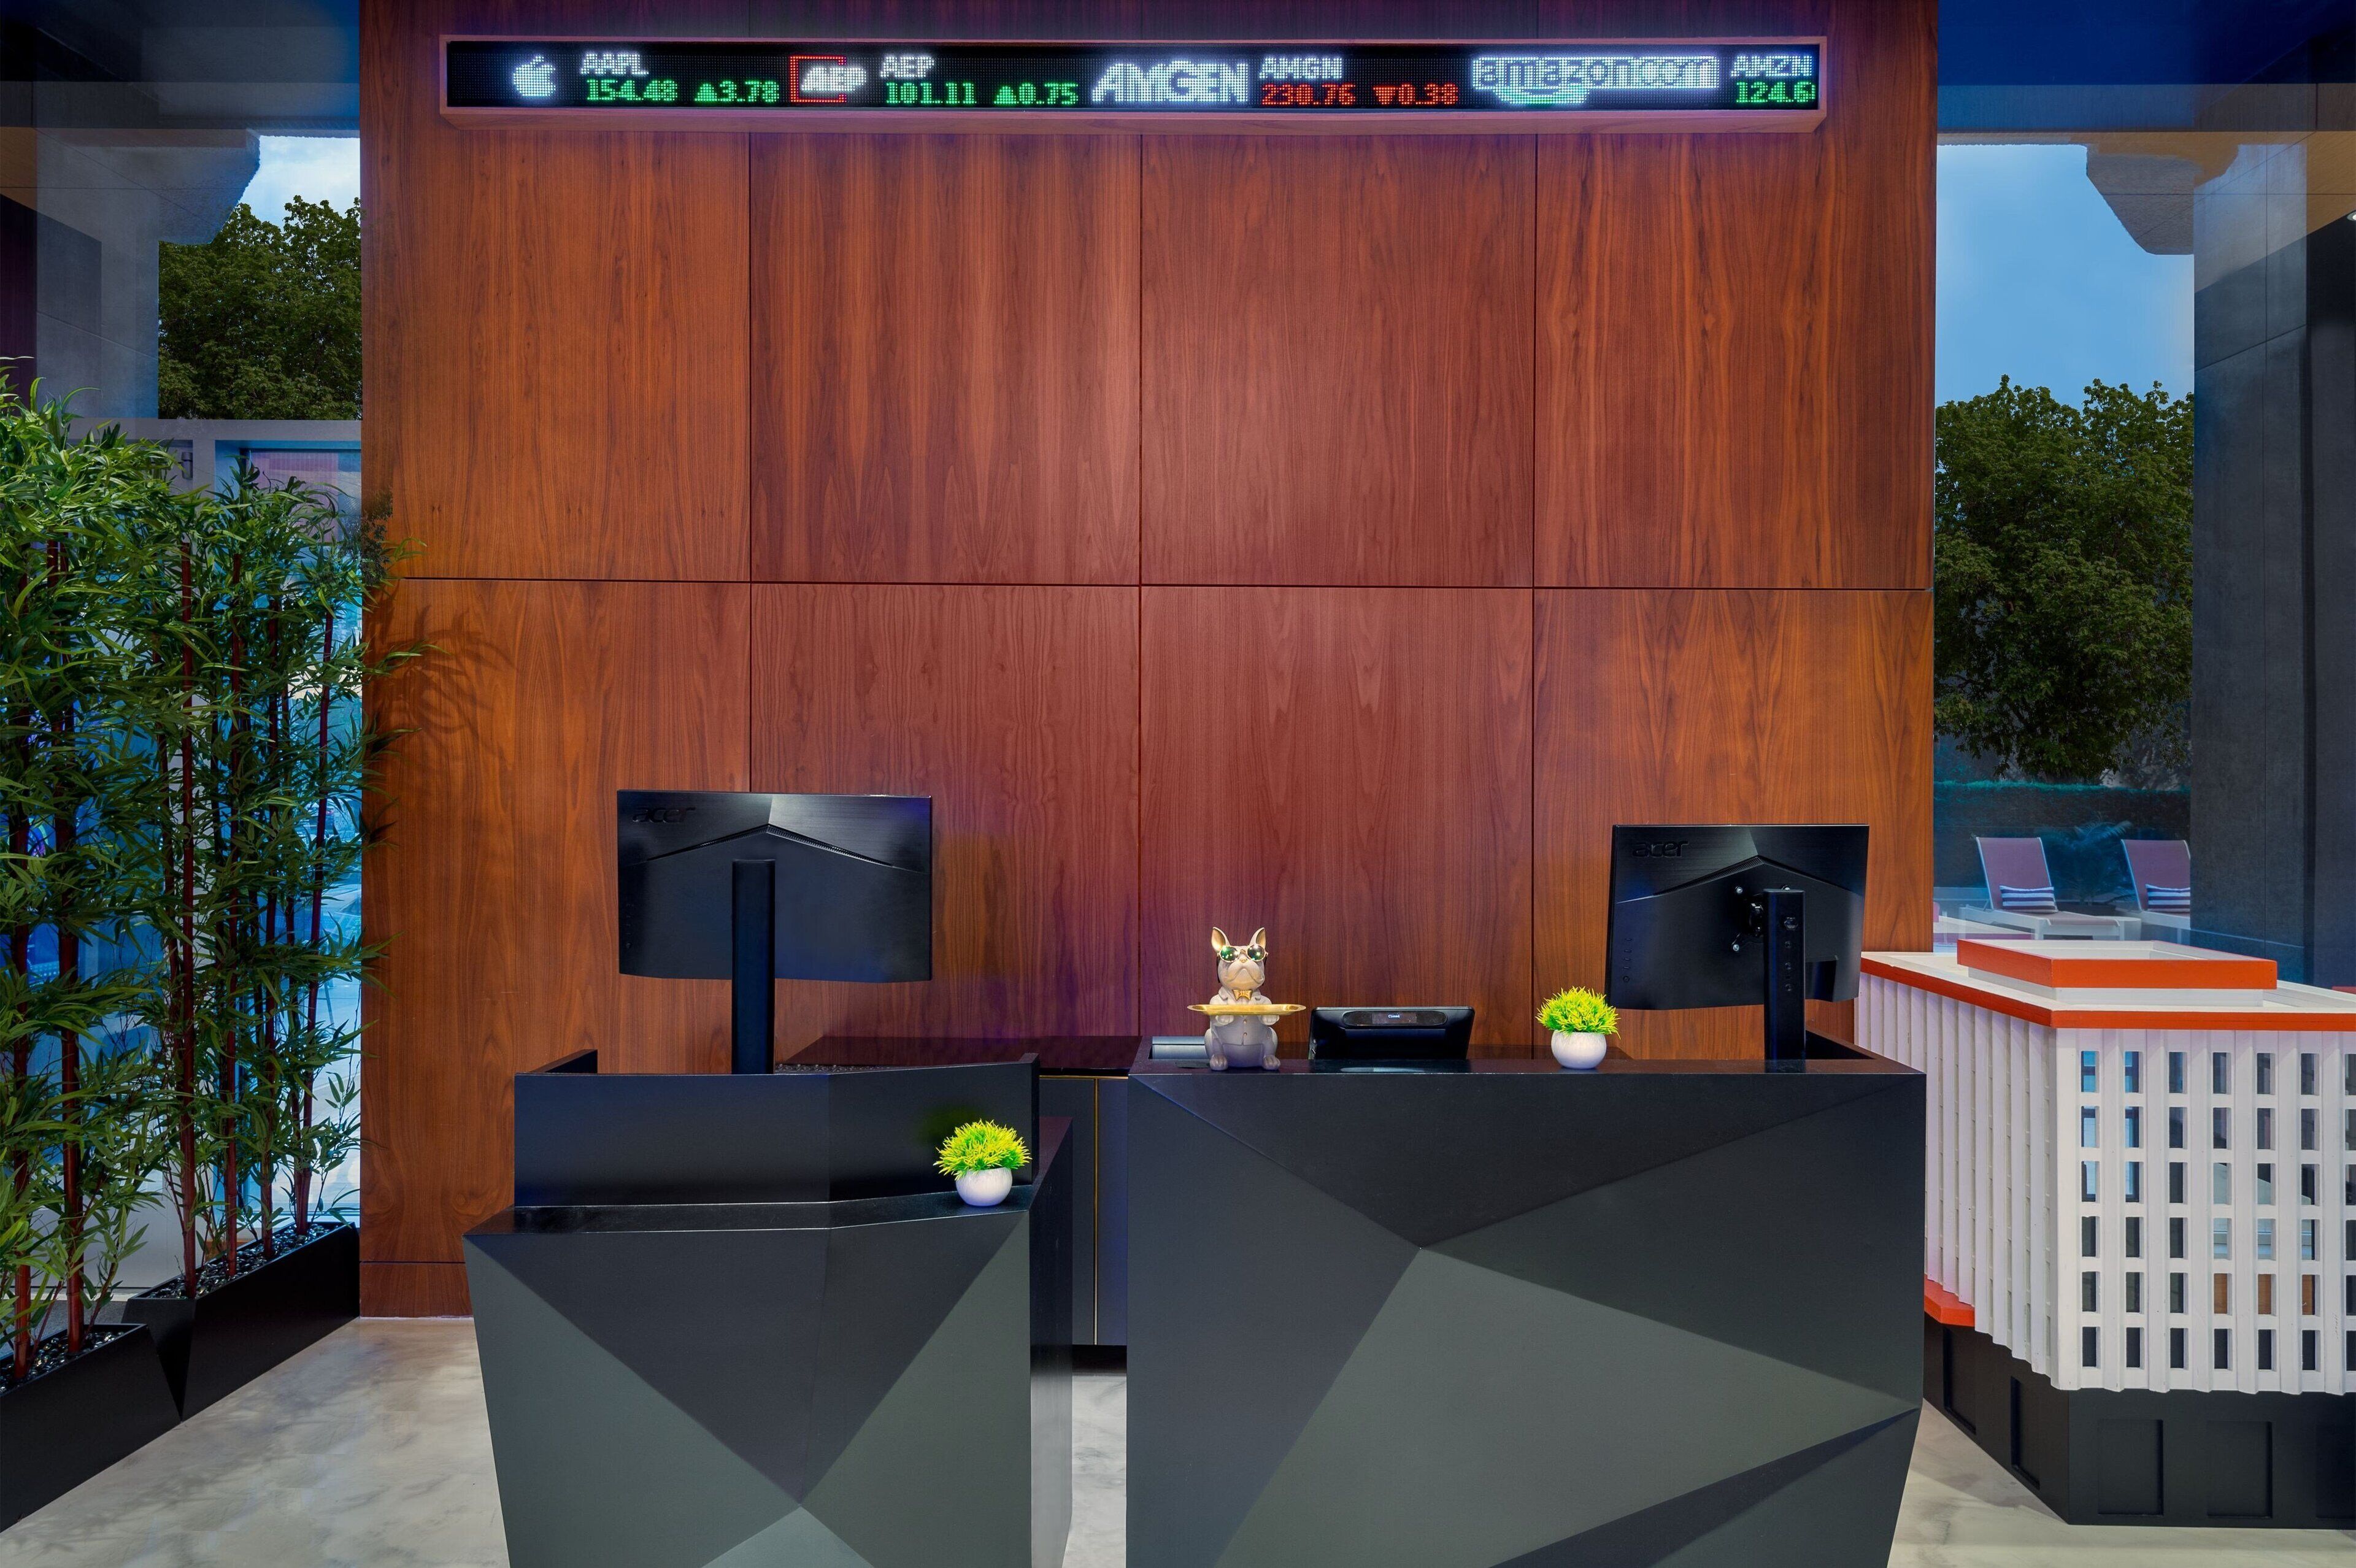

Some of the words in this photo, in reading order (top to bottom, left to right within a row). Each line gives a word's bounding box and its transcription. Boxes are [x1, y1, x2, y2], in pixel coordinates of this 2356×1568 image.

[580, 53, 649, 75] AAPL
[880, 56, 934, 77] AEP
[1260, 57, 1343, 79] AMGN
[1731, 55, 1812, 77] AMZN
[587, 79, 677, 101] 154.48
[1091, 60, 1249, 102] AMGEN
[1736, 82, 1816, 102] 124.6
[886, 82, 977, 104] 101.11
[1261, 83, 1356, 105] 230.76
[632, 806, 696, 823] acer
[1631, 840, 1689, 858] acer
